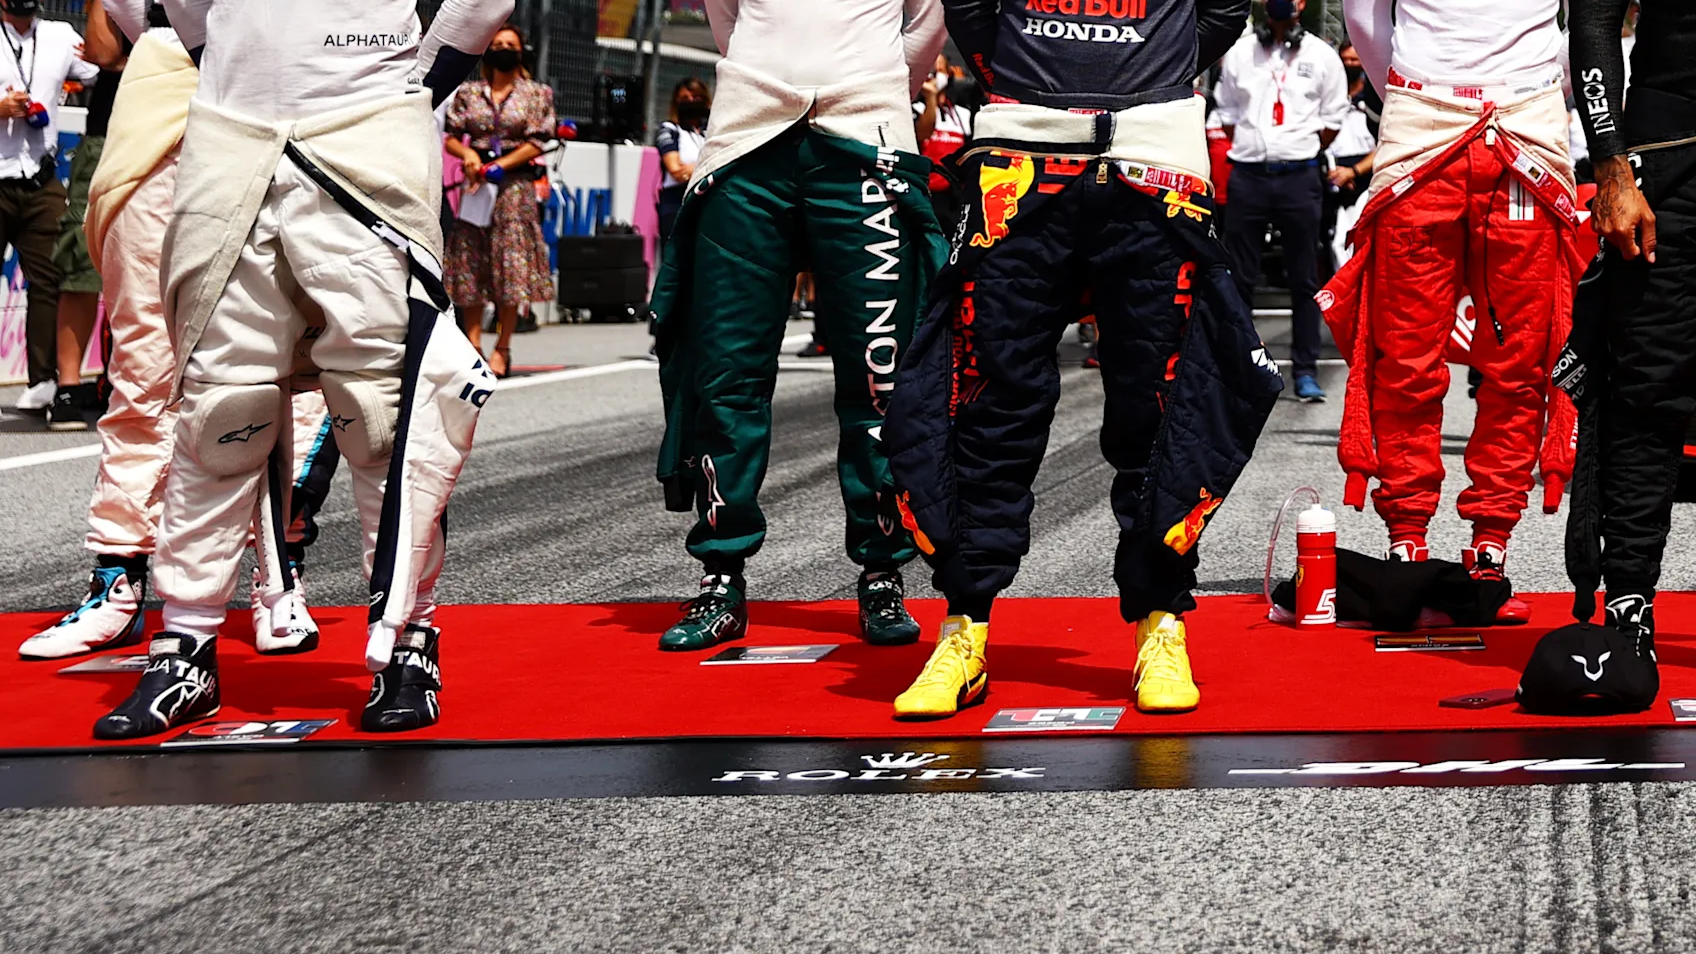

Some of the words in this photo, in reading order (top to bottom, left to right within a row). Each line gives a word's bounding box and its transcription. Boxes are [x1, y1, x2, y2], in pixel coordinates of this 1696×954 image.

[1023, 17, 1146, 43] HONDA
[1581, 67, 1616, 136] INEOS
[711, 767, 1046, 782] ROLEX
[1290, 759, 1622, 775] DHL
